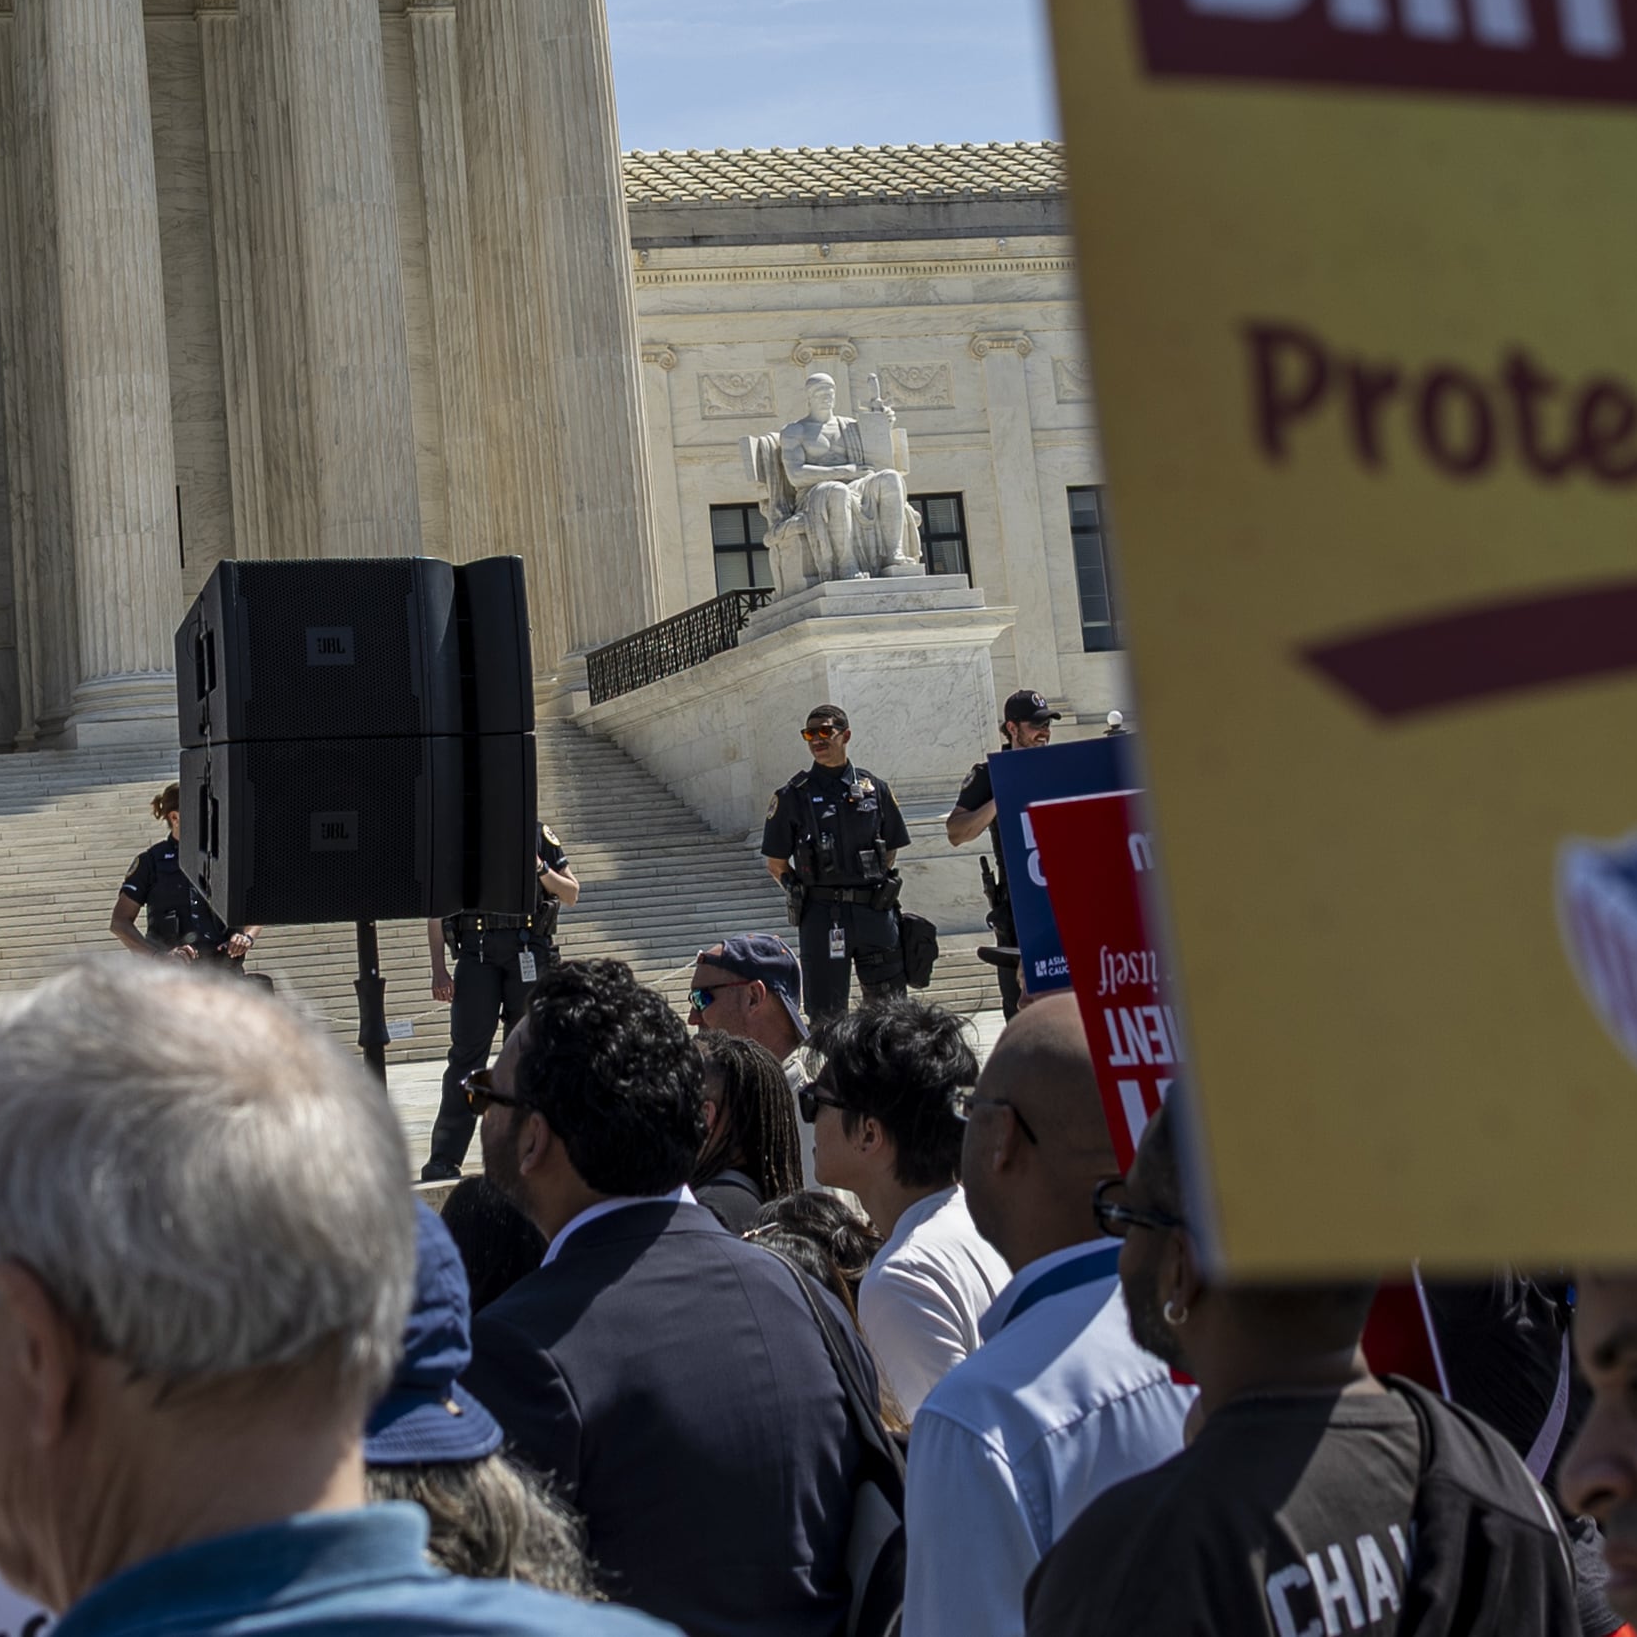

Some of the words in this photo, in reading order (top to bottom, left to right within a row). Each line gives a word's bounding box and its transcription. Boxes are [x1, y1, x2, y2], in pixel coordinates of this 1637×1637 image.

[317, 637, 346, 654] JBL
[321, 823, 349, 840] JBL
[1048, 955, 1068, 966] ASIA
[1097, 945, 1159, 996] itself
